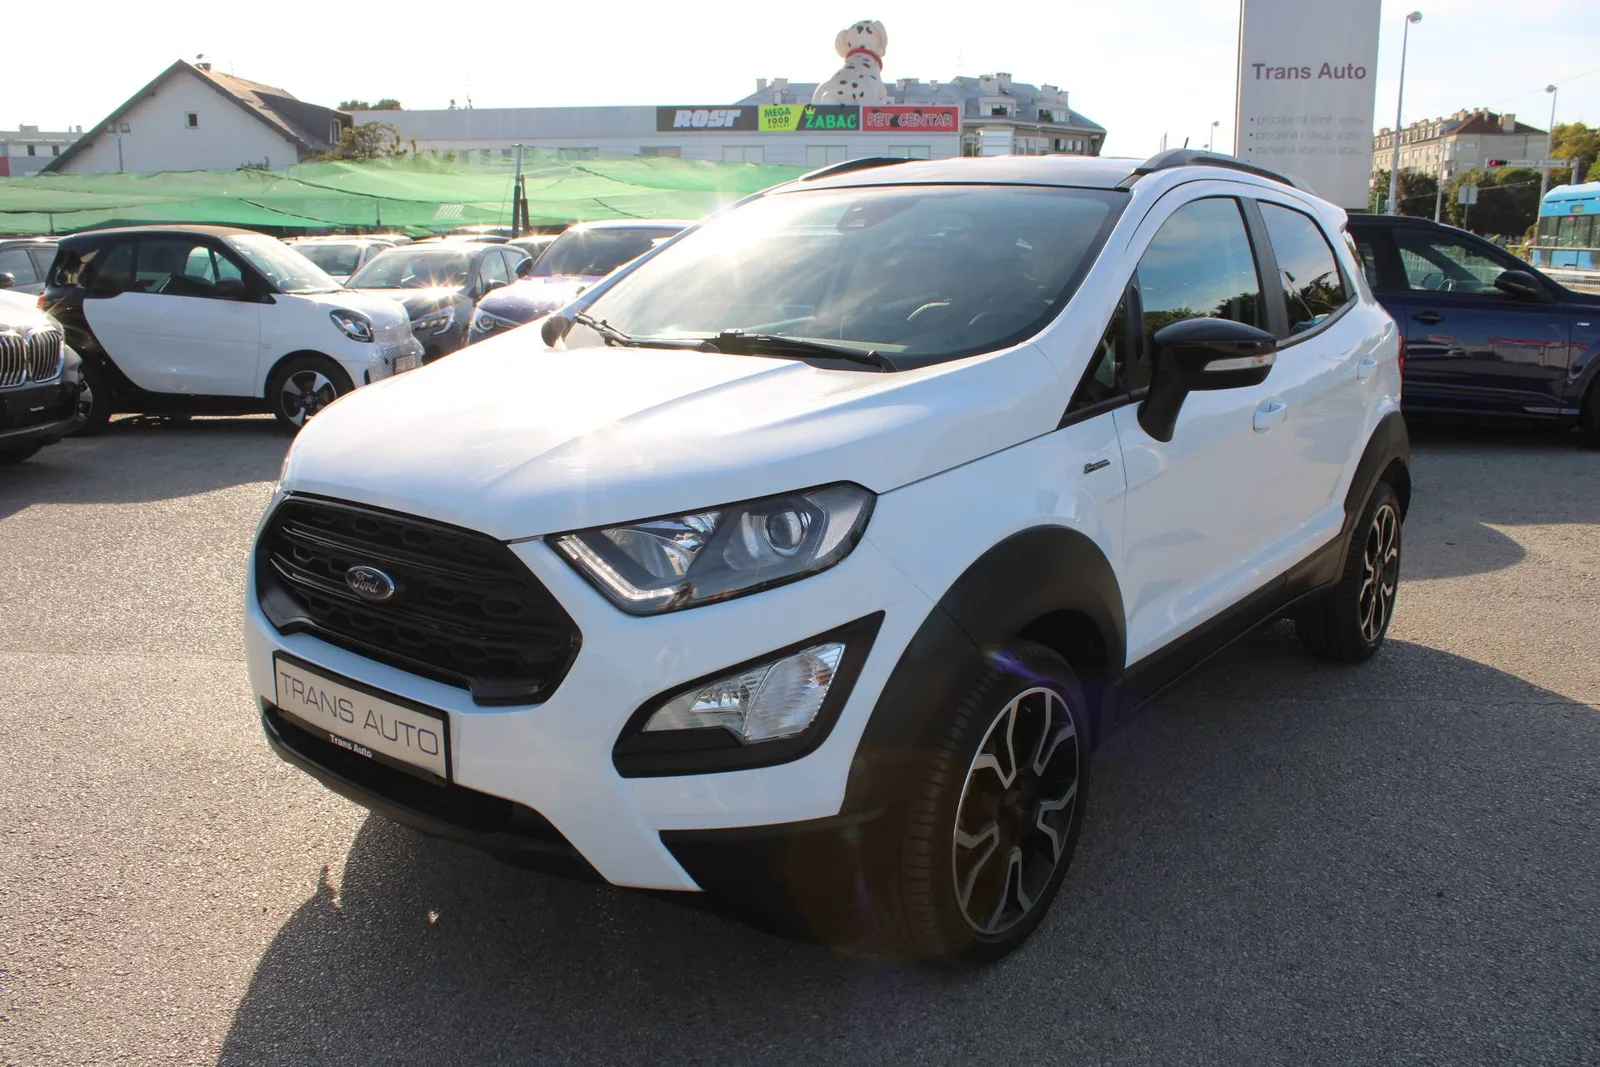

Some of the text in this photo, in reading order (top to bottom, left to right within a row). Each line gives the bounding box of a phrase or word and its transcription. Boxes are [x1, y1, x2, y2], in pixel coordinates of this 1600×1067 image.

[1252, 62, 1367, 80] Trans Auto
[673, 109, 741, 128] ROST
[764, 107, 791, 117] MEGA
[768, 116, 790, 124] FOOD
[867, 113, 953, 127] PET CENTAR
[353, 570, 379, 593] Ford
[280, 671, 439, 756] TRANS AUTO
[329, 733, 373, 758] Trans Auto
